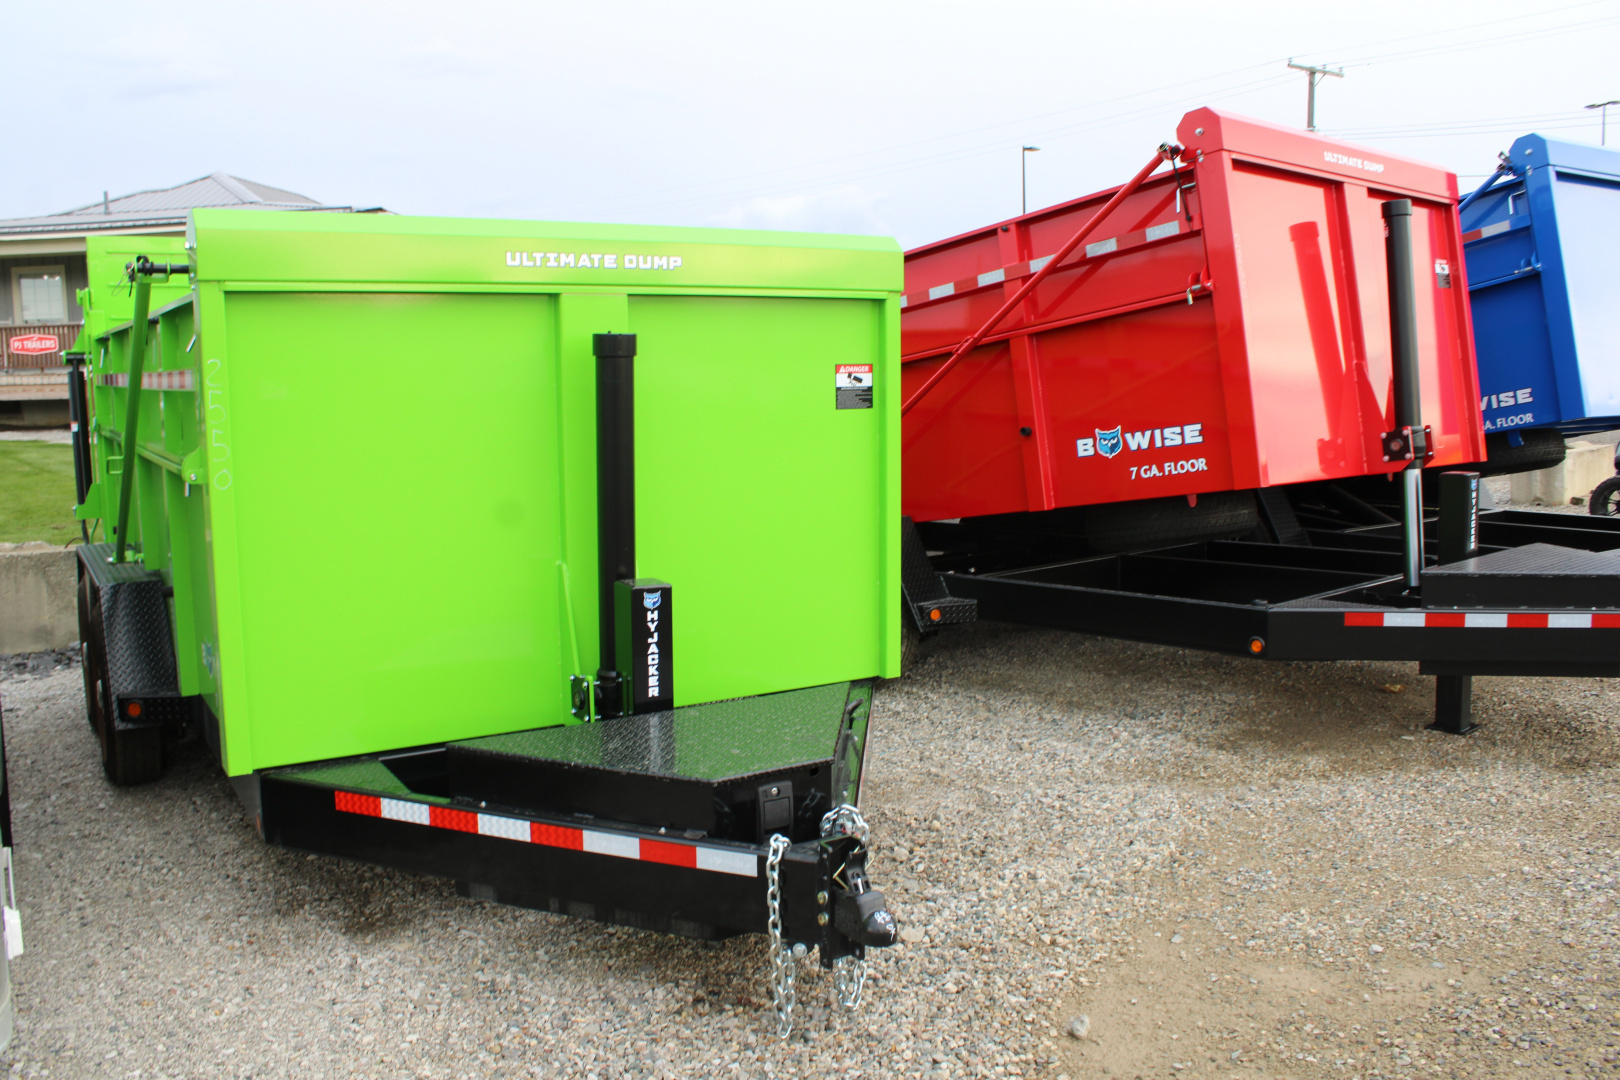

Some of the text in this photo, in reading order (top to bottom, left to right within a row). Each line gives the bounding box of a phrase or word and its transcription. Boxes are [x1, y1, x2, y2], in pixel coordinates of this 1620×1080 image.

[1324, 150, 1385, 174] ULTIMATE DUMP
[505, 251, 683, 271] ULTIMATE DUMP
[23, 339, 56, 349] TRAILERS
[845, 365, 870, 373] DANGER
[206, 358, 233, 491] 2550
[1482, 413, 1535, 430] A. FLOOR
[1129, 458, 1208, 480] 7 GA. FLOOR
[646, 610, 660, 698] HYJACKER
